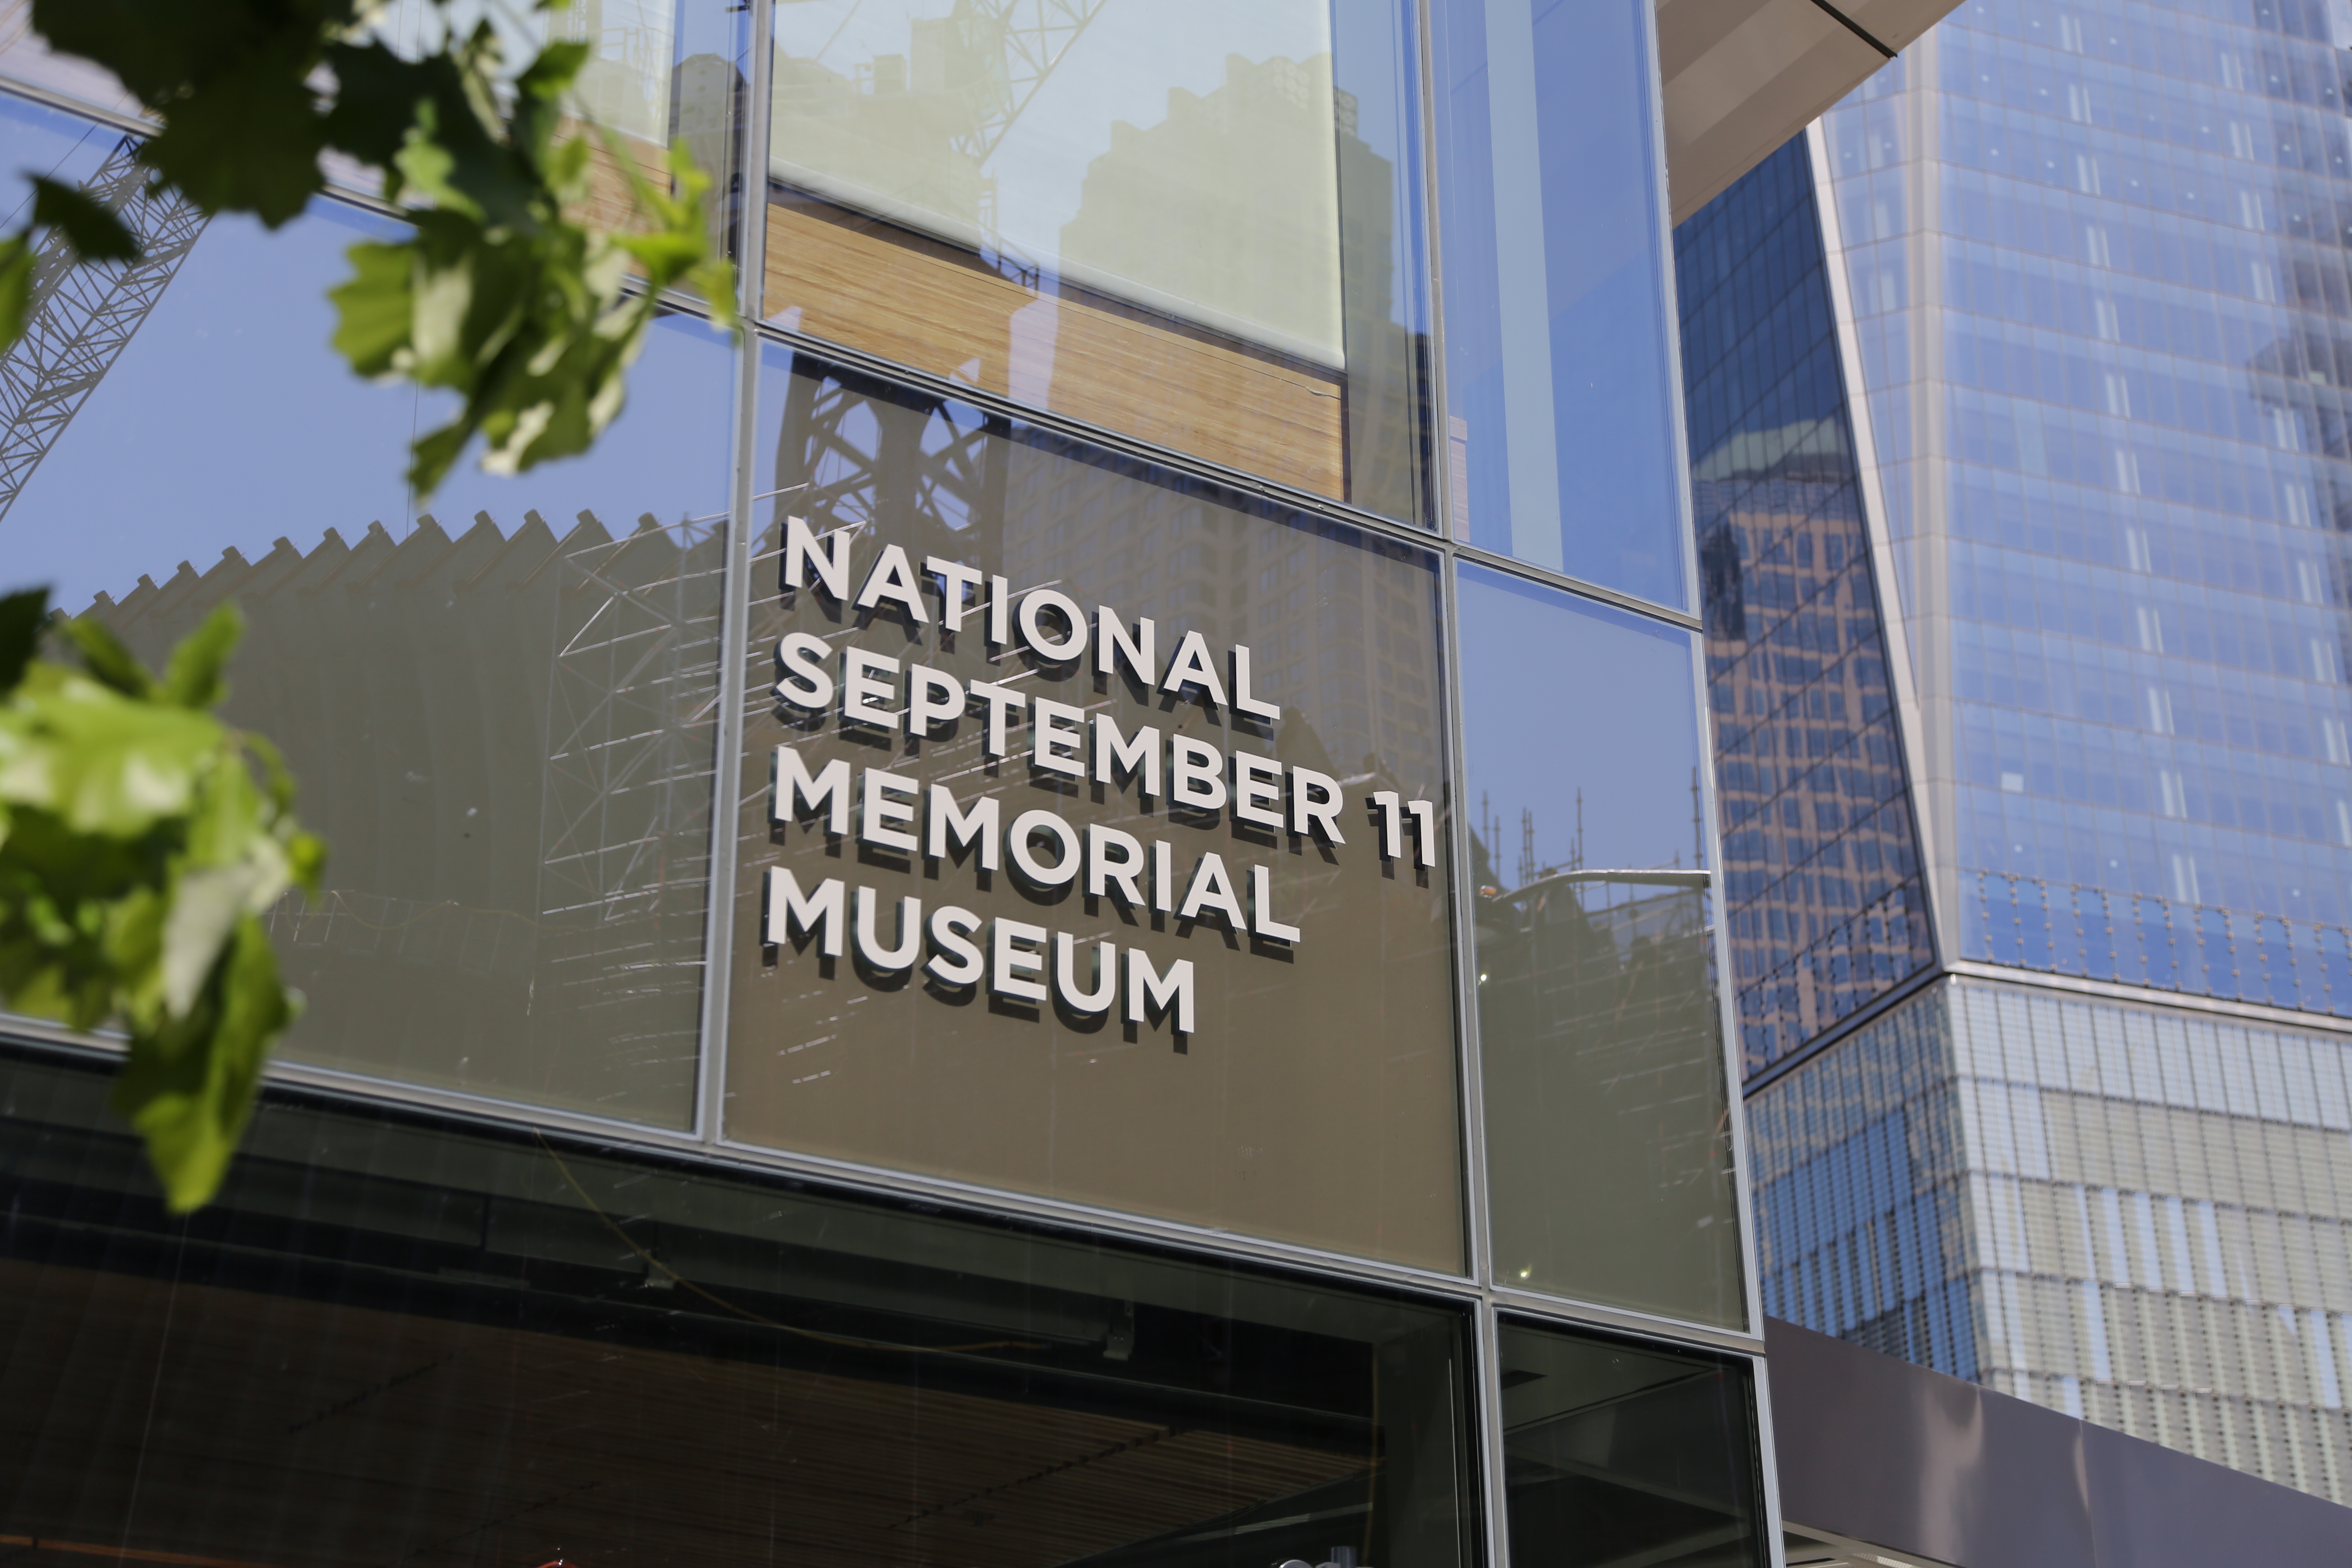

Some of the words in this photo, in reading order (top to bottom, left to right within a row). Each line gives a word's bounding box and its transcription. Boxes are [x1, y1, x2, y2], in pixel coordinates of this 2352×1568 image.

[785, 515, 1280, 720] NATIONAL
[774, 745, 1300, 943] MEMORIAL
[776, 632, 1346, 844] SEPTEMBER
[1372, 791, 1436, 868] 11
[767, 866, 1194, 1033] MUSEUM
